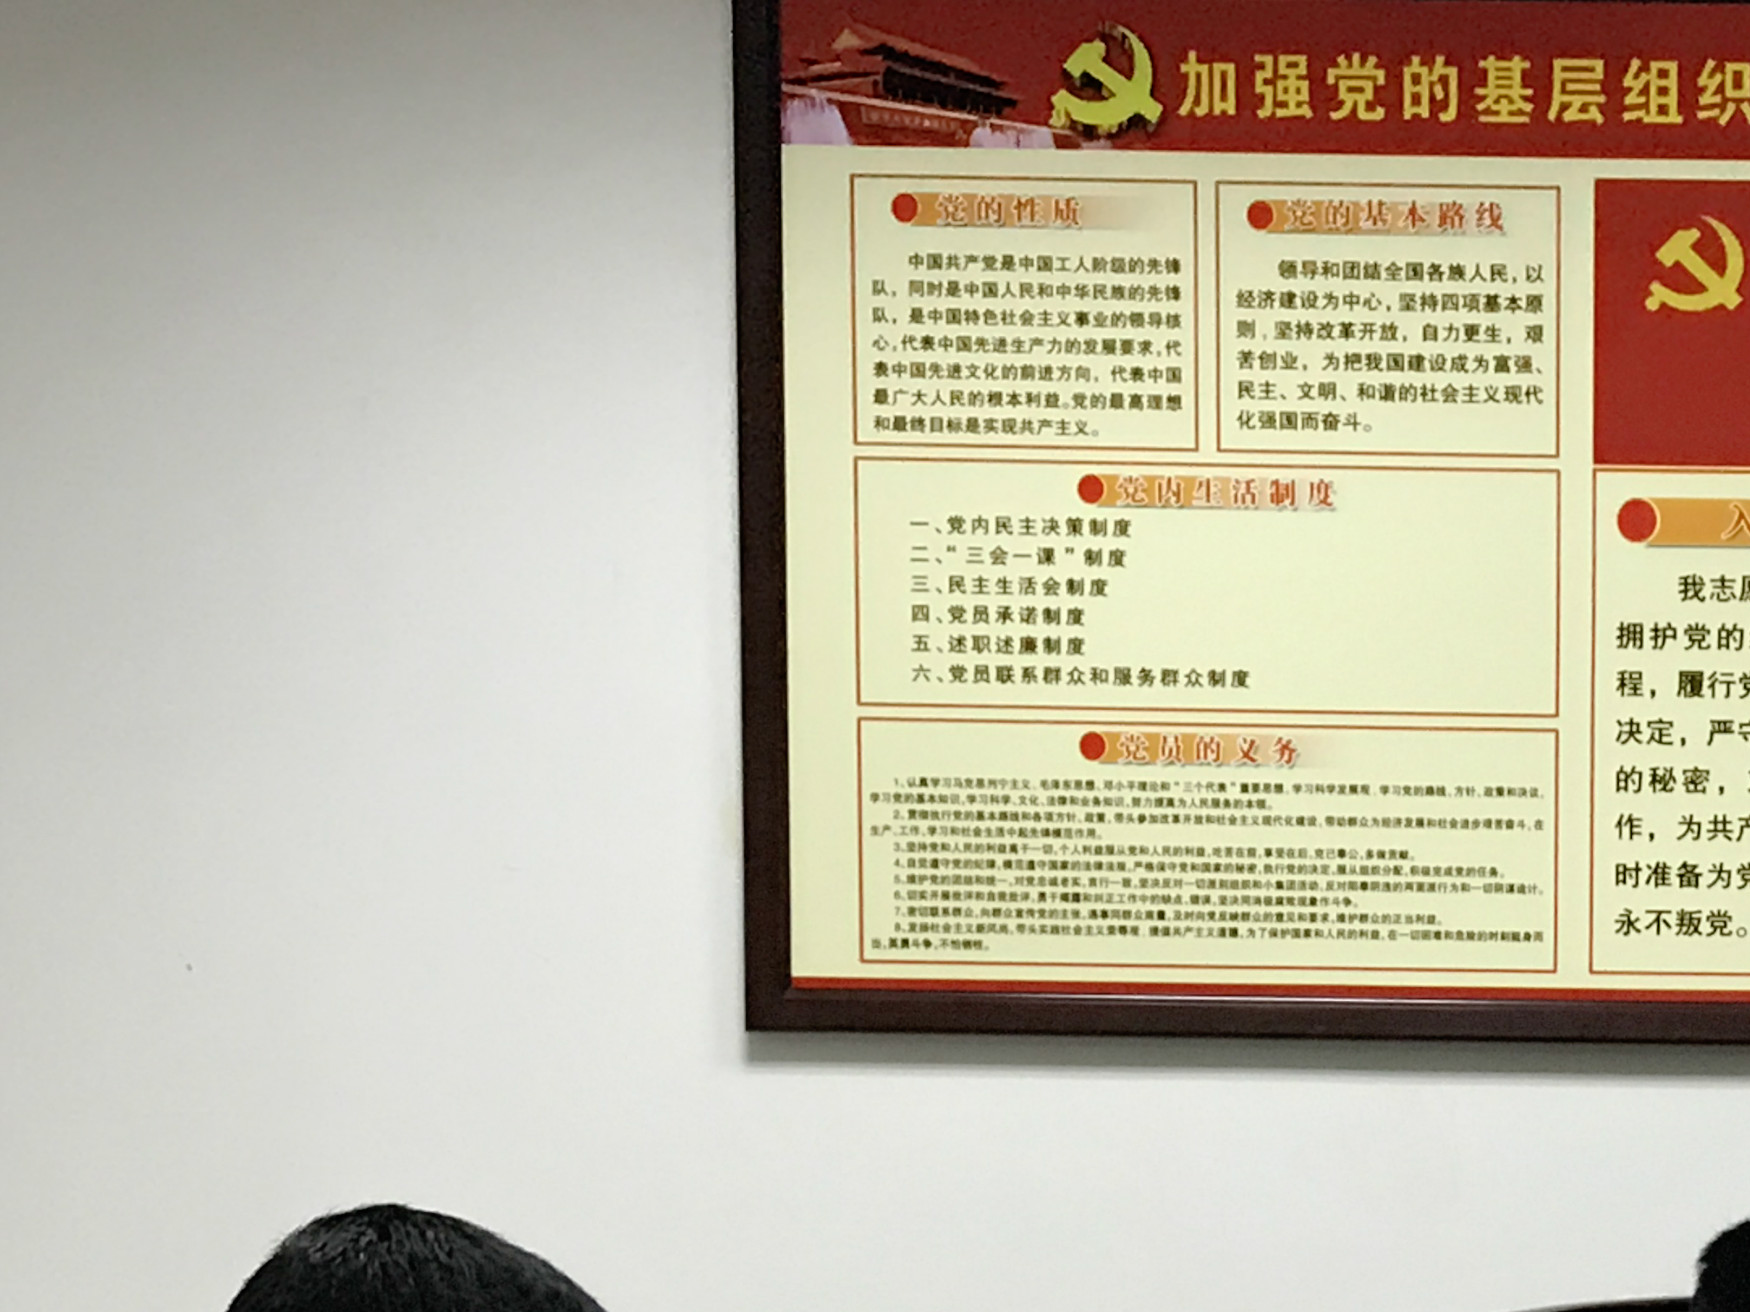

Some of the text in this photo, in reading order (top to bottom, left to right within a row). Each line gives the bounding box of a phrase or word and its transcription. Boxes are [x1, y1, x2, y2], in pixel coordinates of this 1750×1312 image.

[937, 194, 1082, 227] 党的性质
[1286, 198, 1505, 233] 党的基本路线
[1115, 475, 1336, 509] 党内生活制度
[1117, 734, 1299, 765] 党员的义务
[1613, 907, 1749, 939] 永不叛党。
